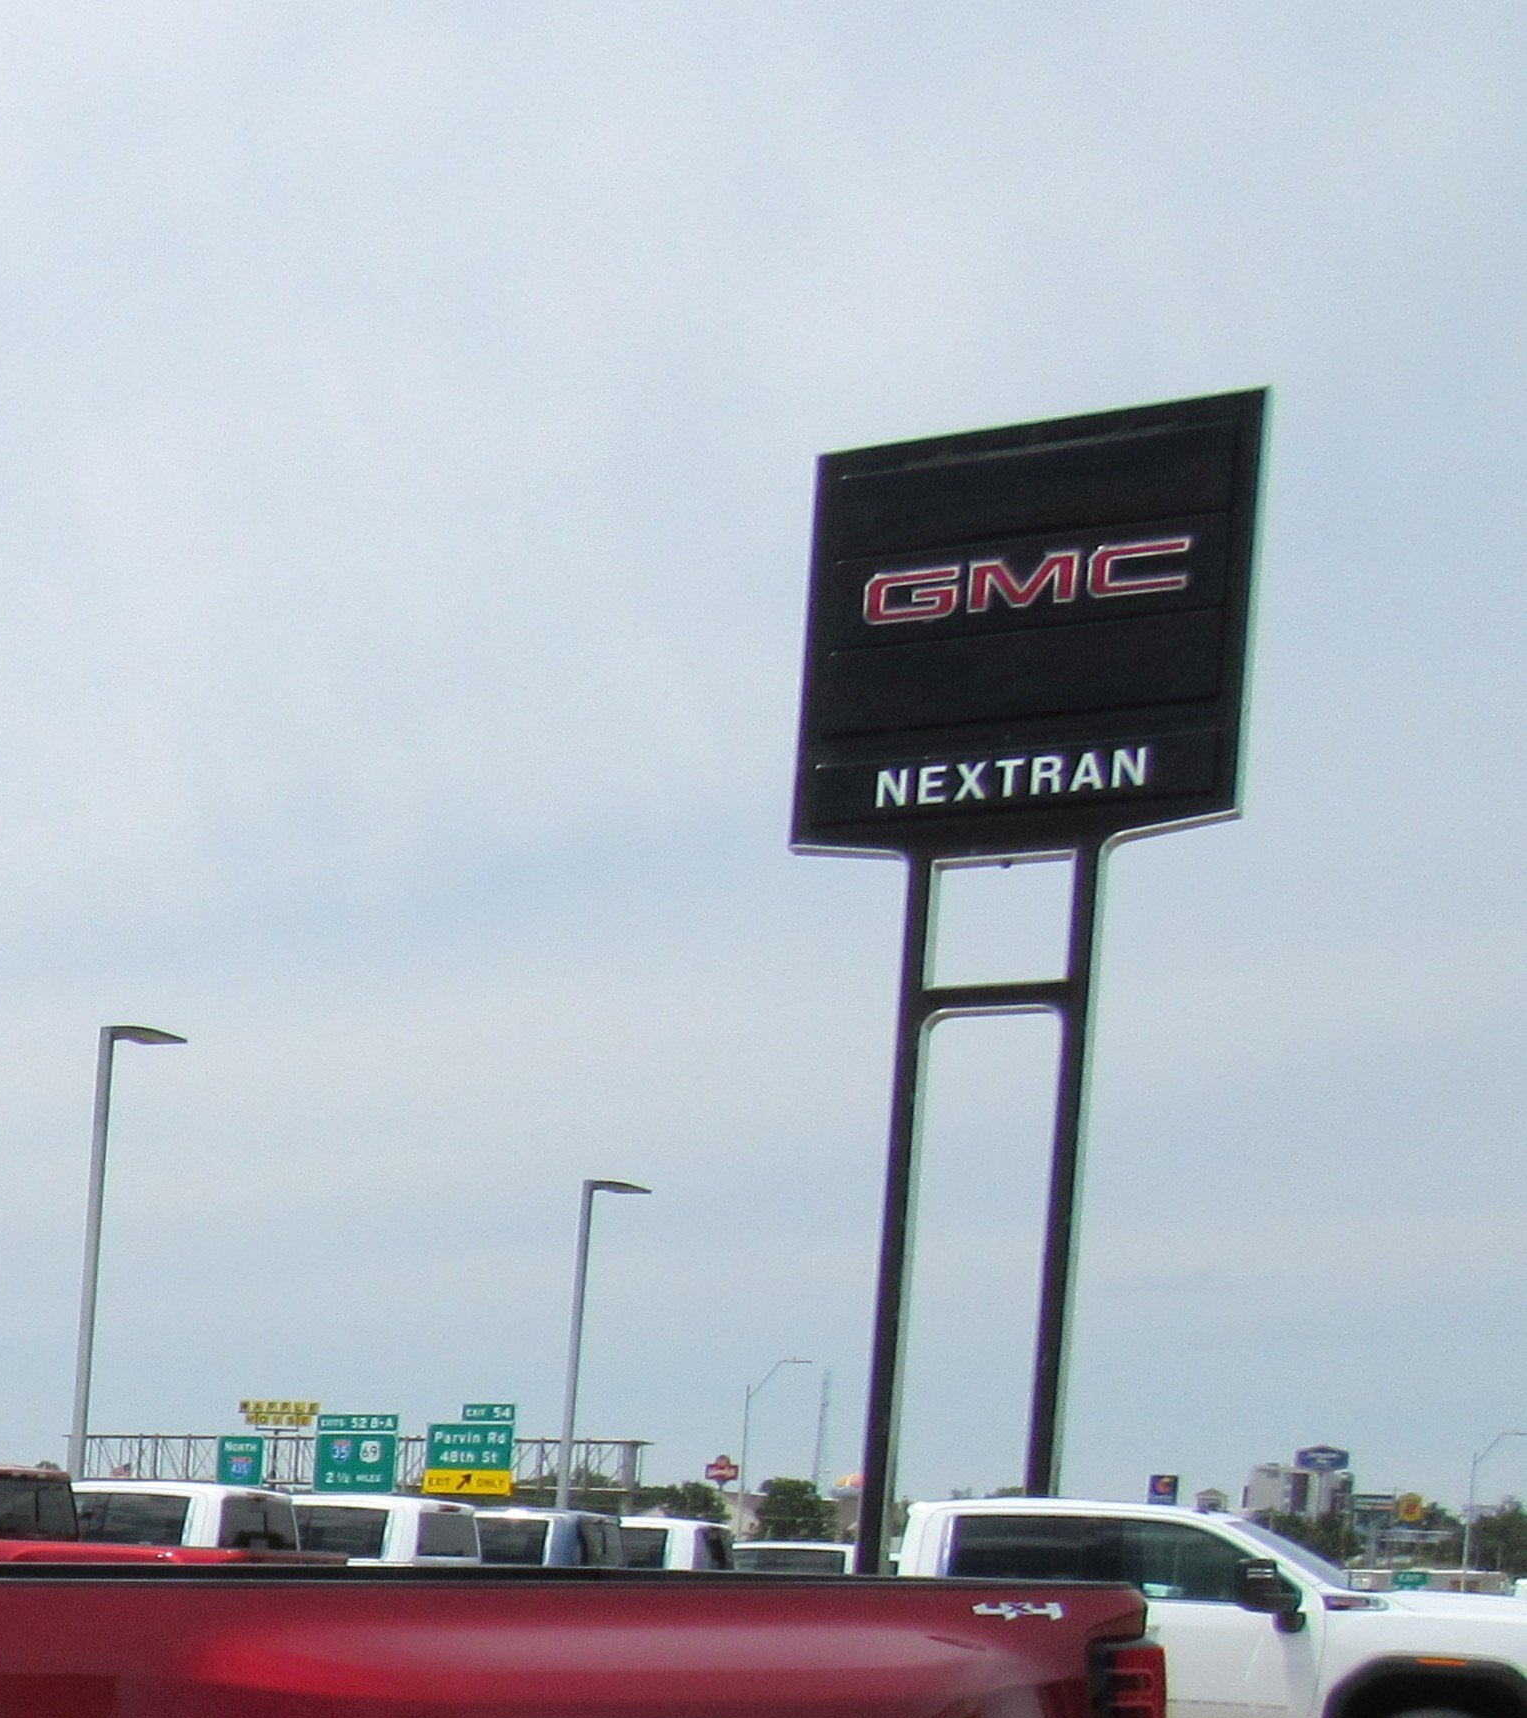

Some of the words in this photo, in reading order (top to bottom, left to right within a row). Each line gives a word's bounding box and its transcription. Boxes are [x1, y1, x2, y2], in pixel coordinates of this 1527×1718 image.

[863, 537, 1190, 625] GMC
[874, 746, 1150, 808] NEXTRAN
[466, 1408, 485, 1417] EXIT
[493, 1406, 511, 1419] 54
[351, 1417, 367, 1428] 52
[370, 1417, 394, 1428] B-A
[434, 1431, 481, 1444] Parvin
[487, 1431, 506, 1444] Rd
[333, 1447, 346, 1459] 35
[362, 1445, 378, 1458] 69
[439, 1450, 475, 1463] 48th
[481, 1451, 498, 1463] St
[428, 1477, 451, 1487] EXIT
[476, 1478, 504, 1488] ONLY
